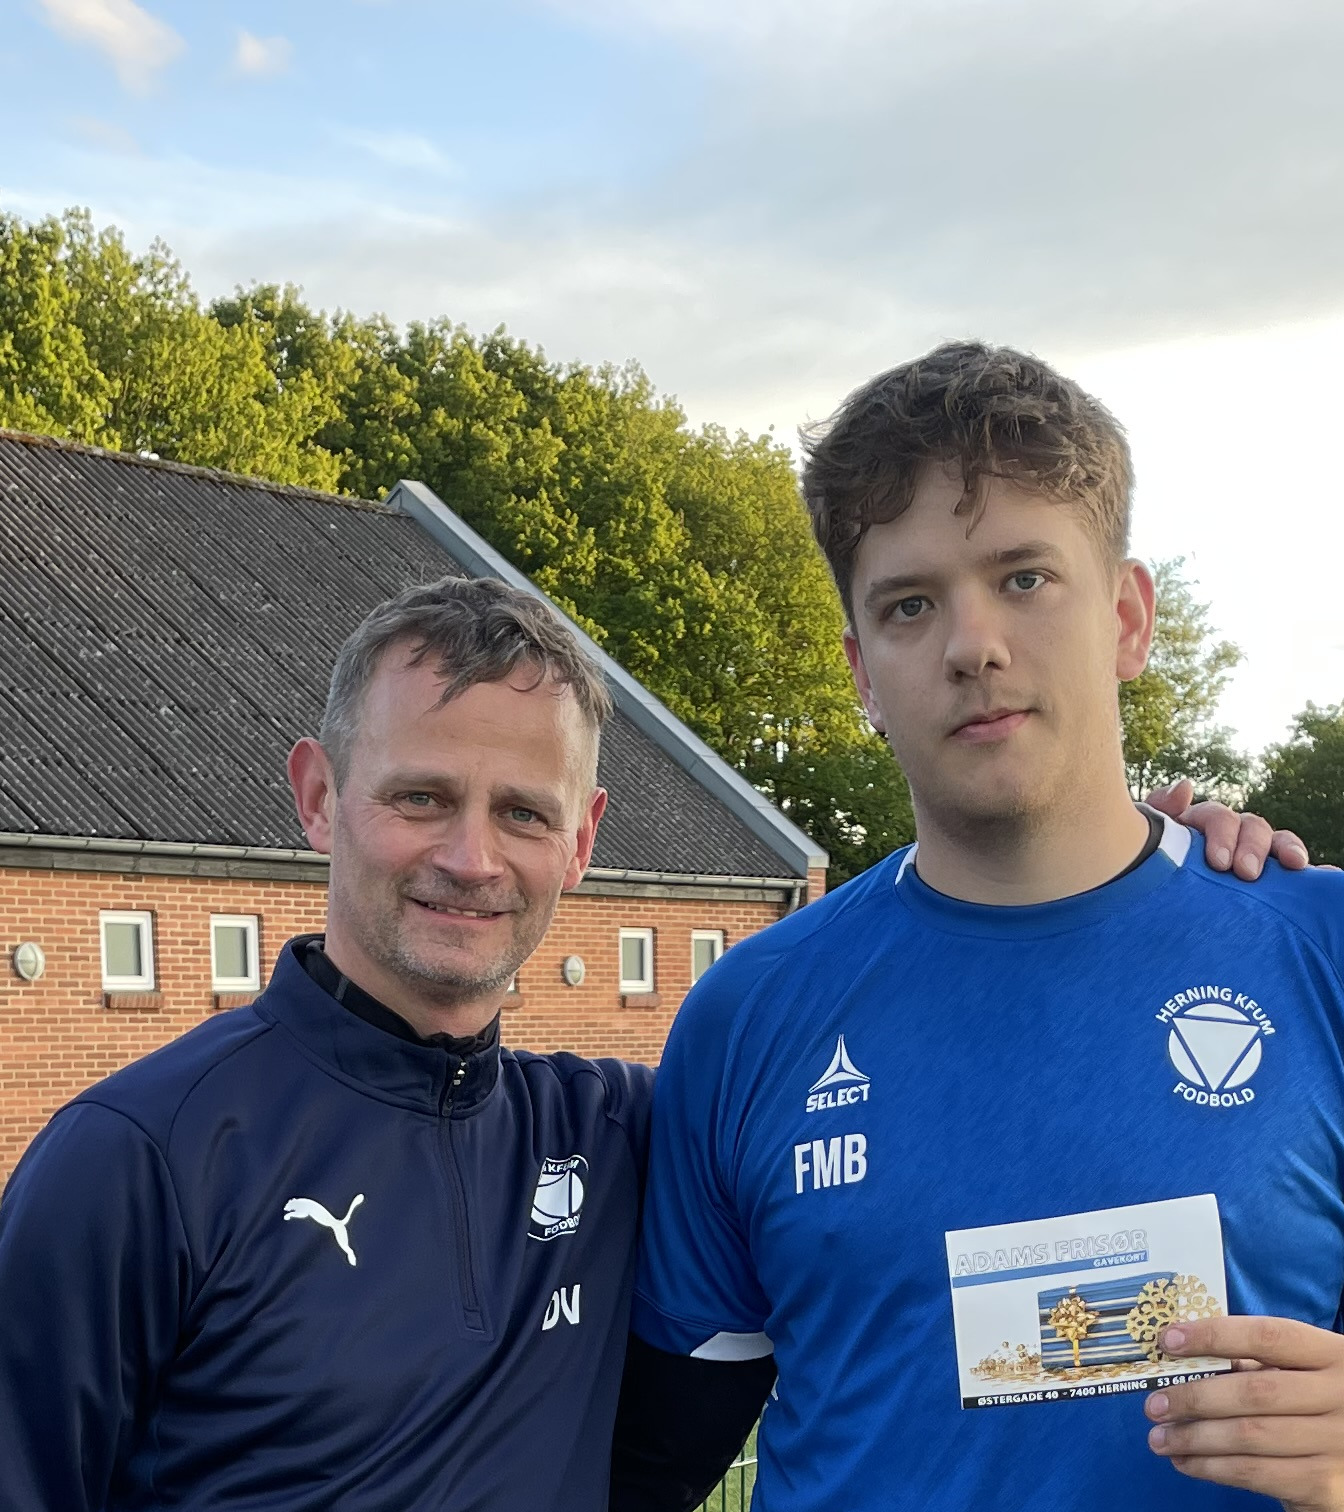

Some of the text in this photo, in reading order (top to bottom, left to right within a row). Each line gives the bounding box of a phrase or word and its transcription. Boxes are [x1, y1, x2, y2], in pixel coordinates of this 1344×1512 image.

[1155, 985, 1276, 1036] HERNING KFUM
[806, 1083, 871, 1112] SELECT
[1173, 1082, 1255, 1107] FODBOLD
[794, 1133, 868, 1195] FMB
[544, 1213, 581, 1236] FODBO
[955, 1229, 1148, 1275] ADAMS FRISØR
[977, 1391, 1043, 1406] ØSTERGADE
[1045, 1391, 1059, 1400] 40
[1069, 1386, 1096, 1398] 7400
[1097, 1379, 1148, 1395] HERNING
[1157, 1377, 1170, 1387] 53
